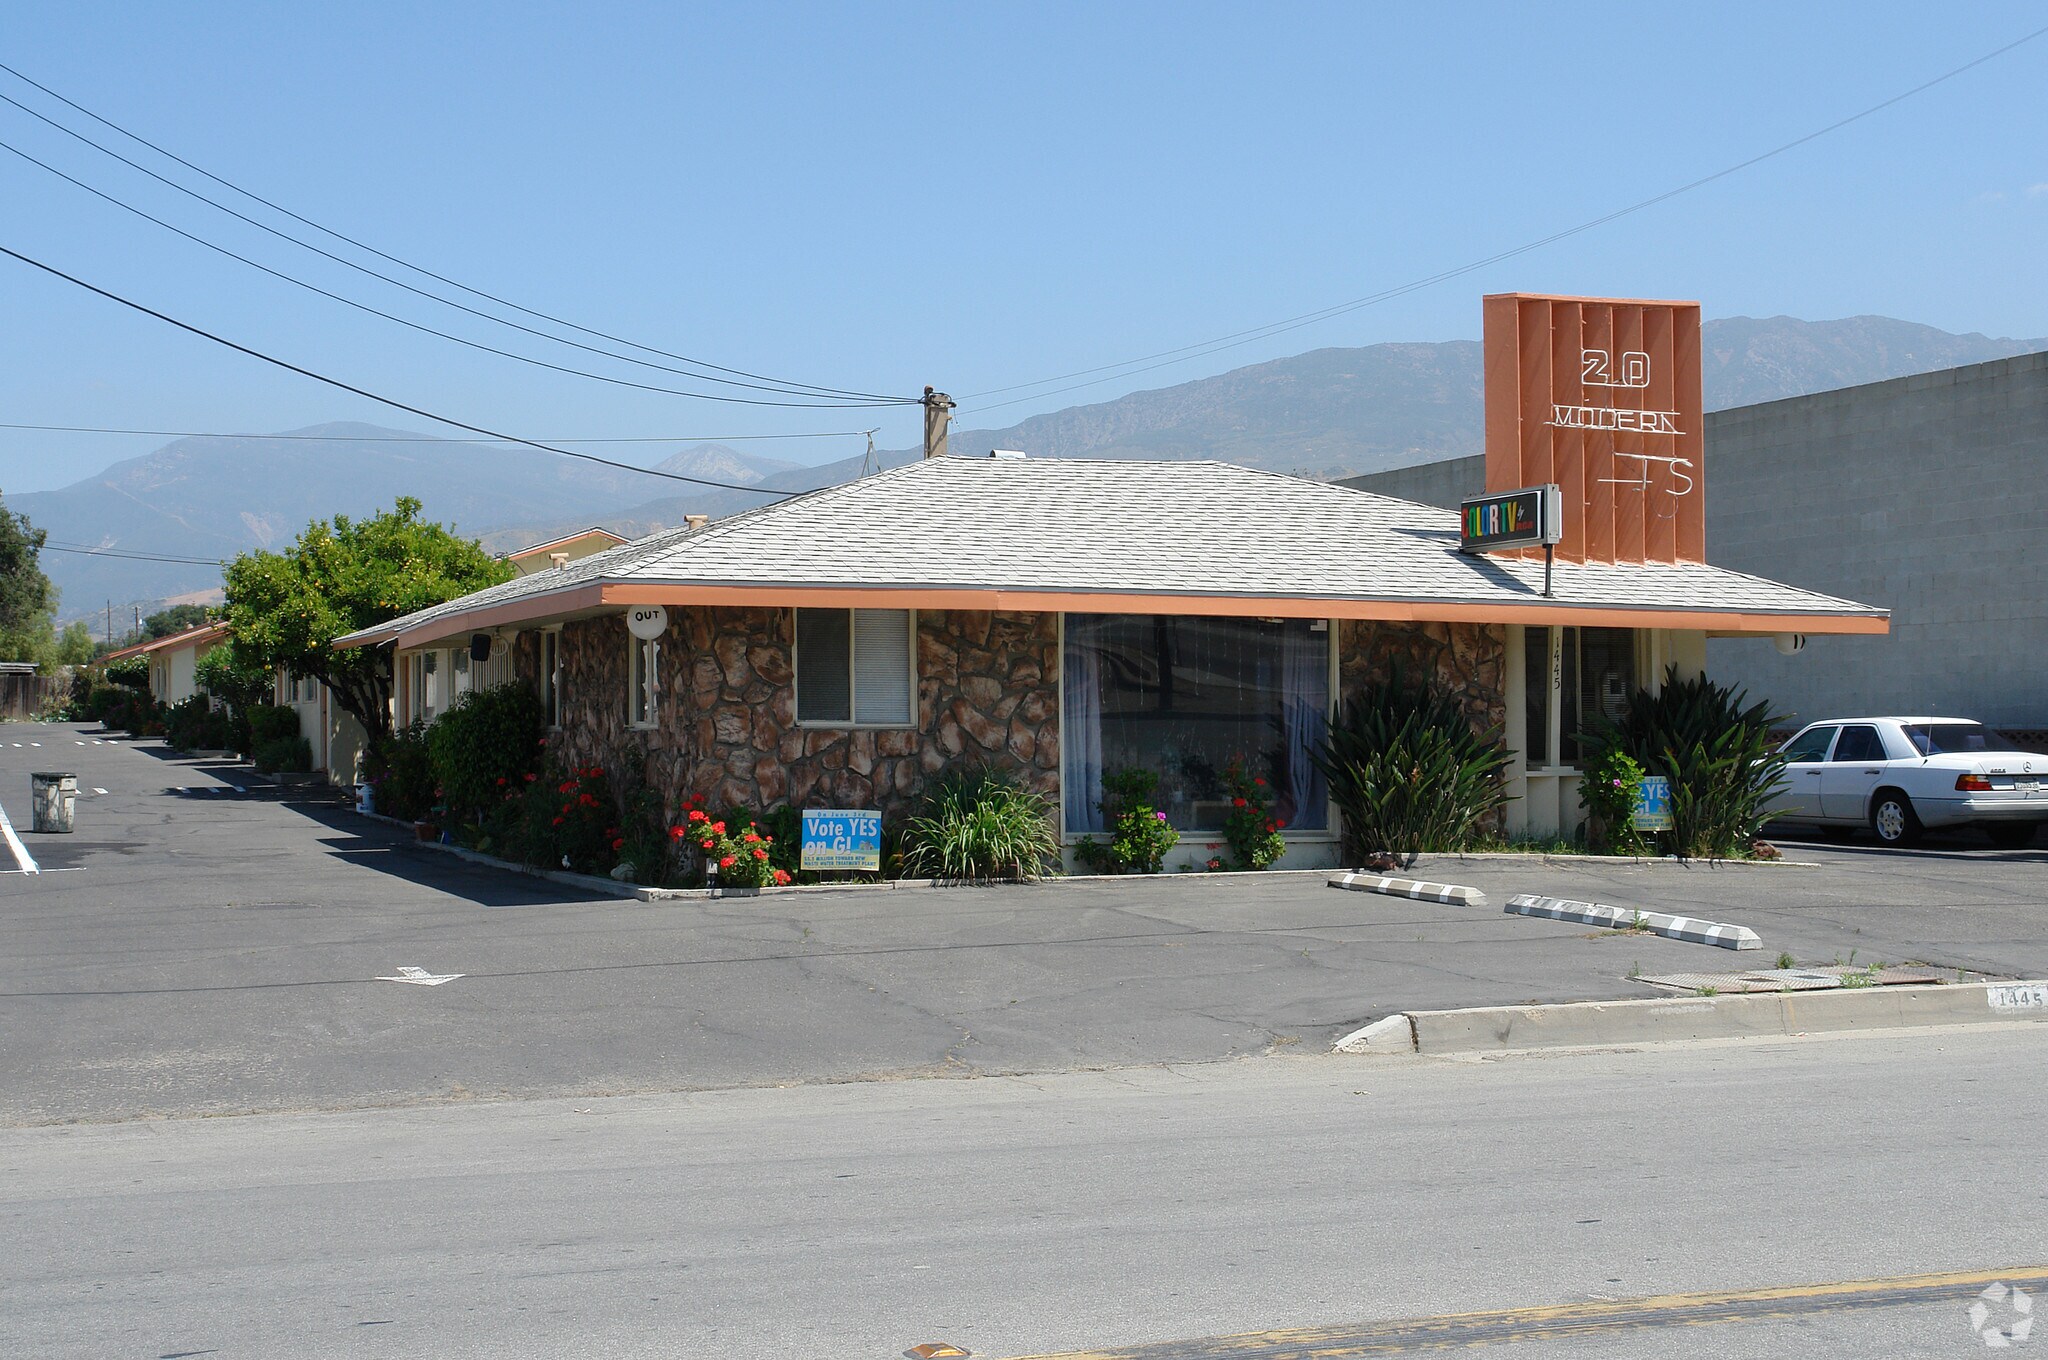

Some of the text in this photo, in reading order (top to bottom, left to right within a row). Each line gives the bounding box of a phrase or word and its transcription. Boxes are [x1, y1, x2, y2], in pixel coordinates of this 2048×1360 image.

[1581, 349, 1651, 388] 20
[1554, 406, 1679, 434] MODERN
[1461, 504, 1499, 538] COLOR
[1500, 501, 1518, 533] TV
[635, 610, 660, 622] OUT
[1553, 637, 1561, 690] 1445
[1646, 784, 1671, 800] YES
[807, 818, 877, 837] Vote YES
[805, 836, 851, 856] on G!
[2000, 991, 2043, 1007] 1445
